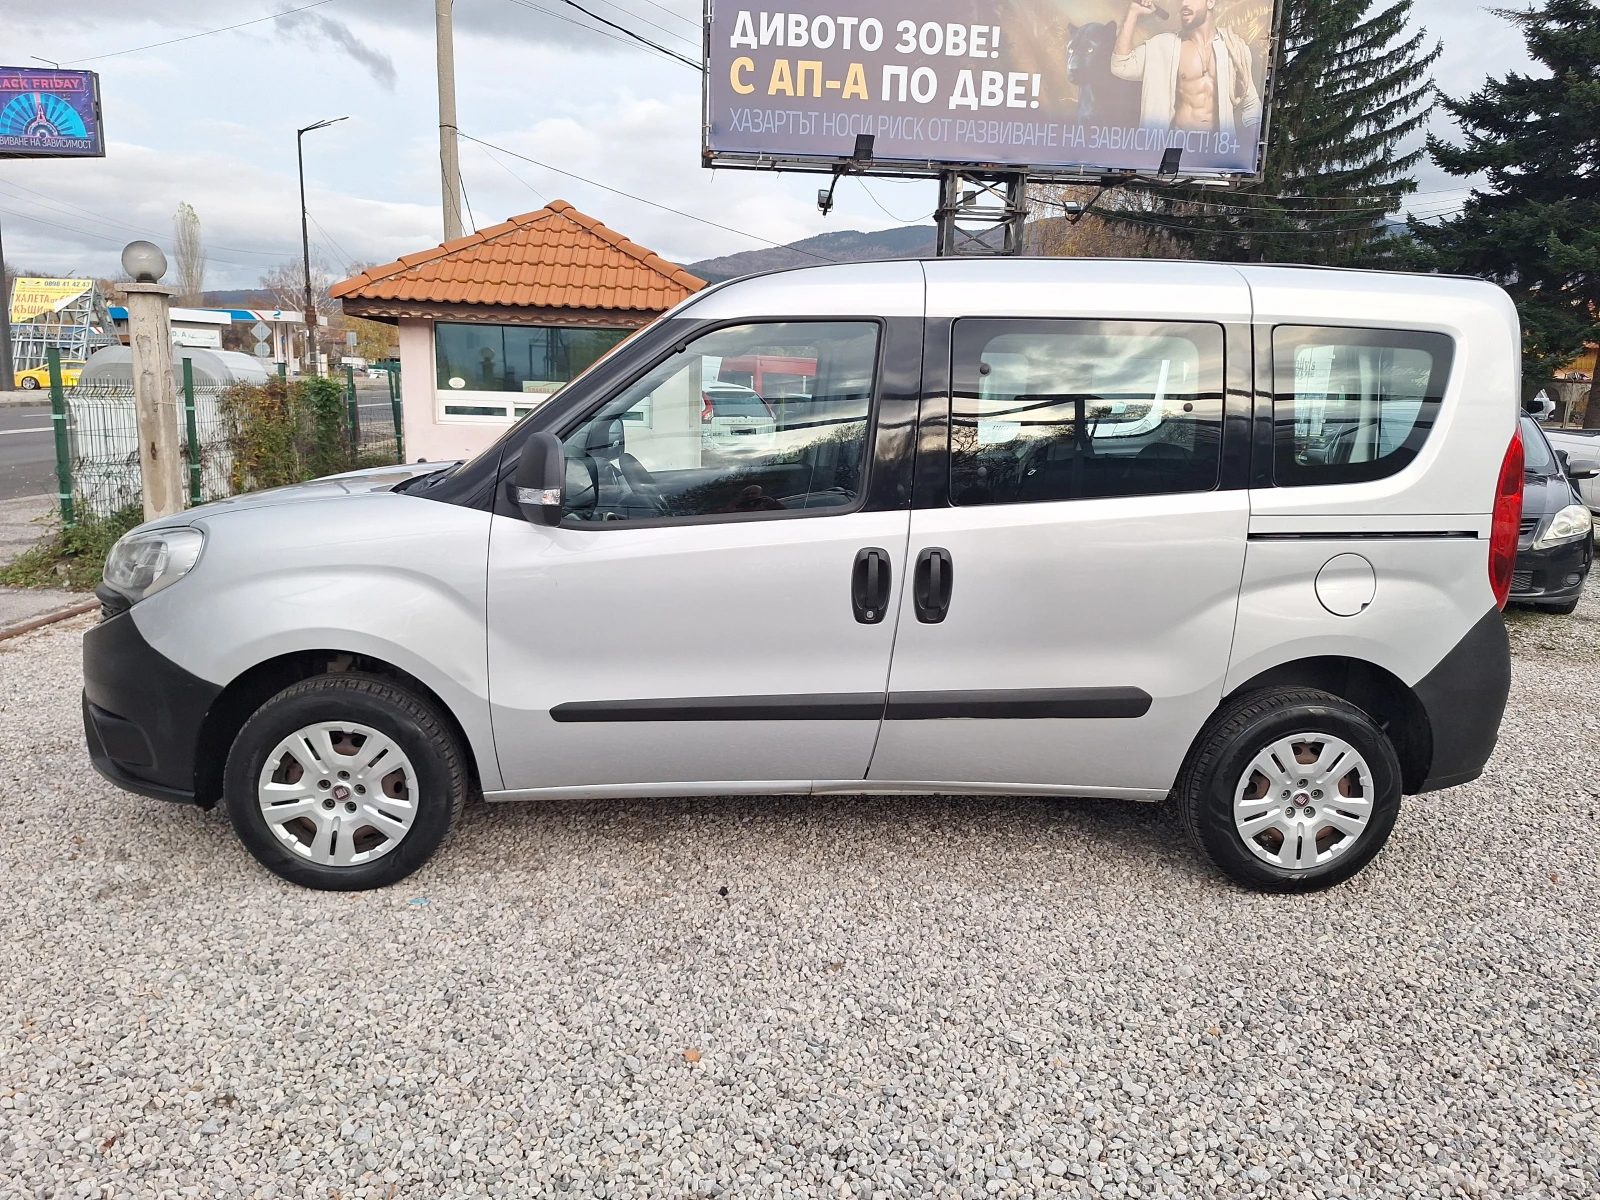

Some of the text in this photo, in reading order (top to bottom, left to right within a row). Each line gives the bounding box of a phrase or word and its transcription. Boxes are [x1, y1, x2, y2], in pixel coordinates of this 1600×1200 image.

[730, 10, 1000, 59] ДИВОТО ЗОВЕ!
[0, 78, 80, 89] ACK FRIDAY
[730, 56, 1042, 109] С АП-А ПО ДВЕ!
[729, 107, 1241, 155] ХАЗАРТЪТ НОСИ РИСК ОТ РАЗВИВАНЕ НА ЗАВИСИМОСТ! 18+
[30, 139, 40, 148] НА
[41, 138, 92, 149] ЗАВИСИМОСТ
[14, 293, 50, 304] ХАЛЕТА
[13, 304, 43, 315] КЪЩИ
